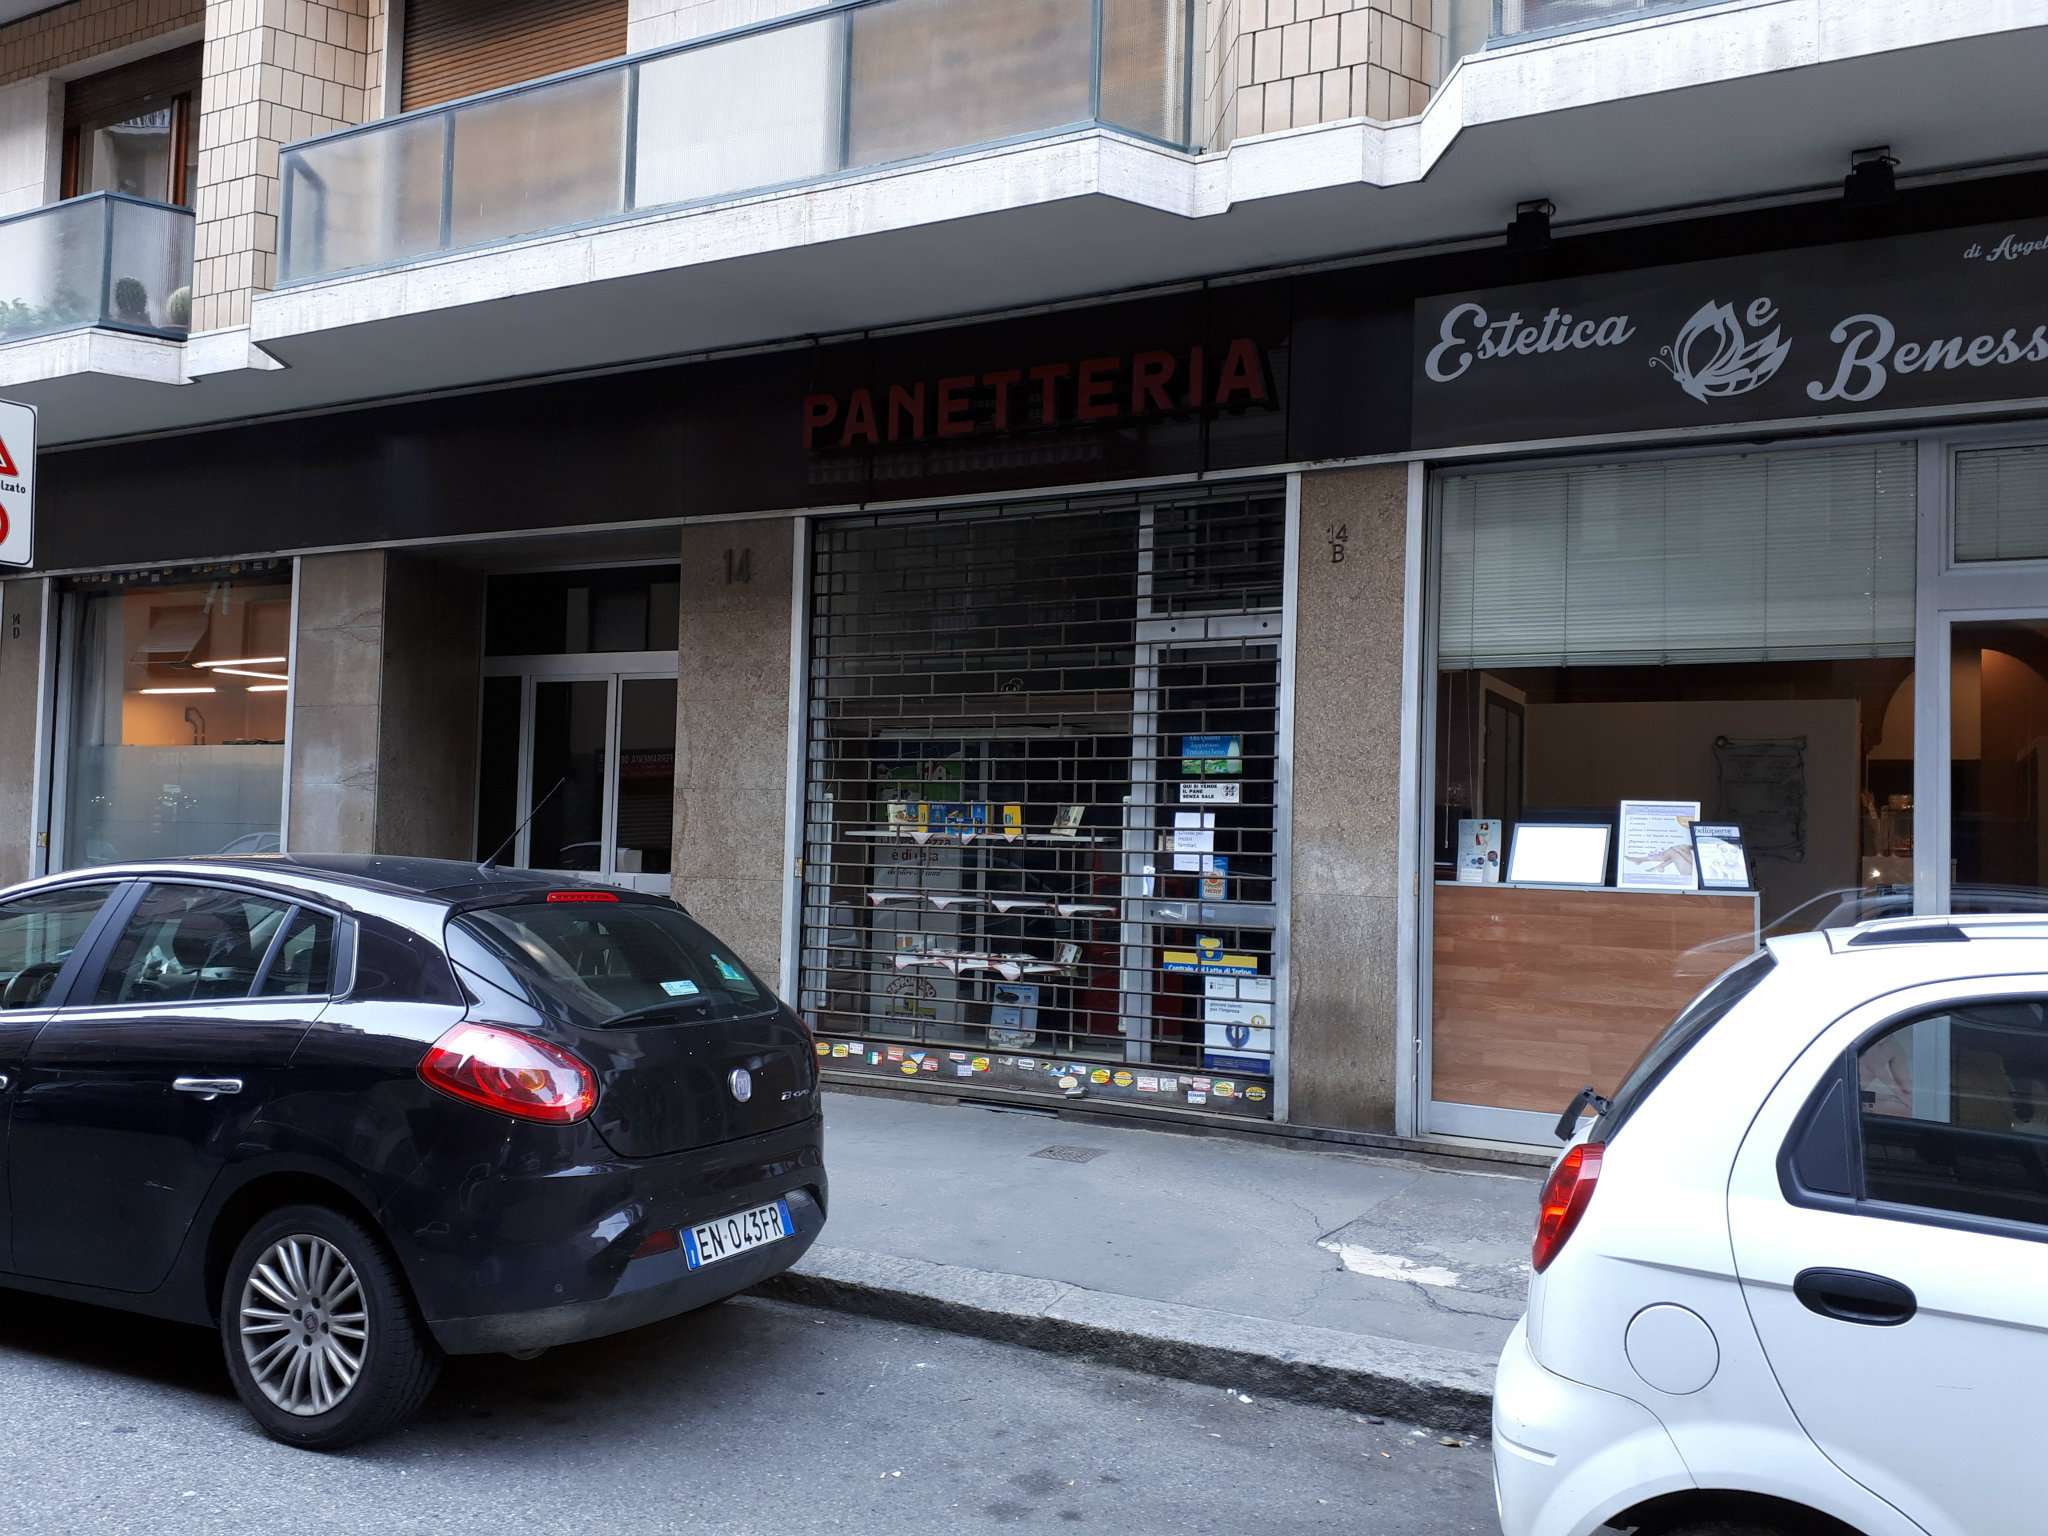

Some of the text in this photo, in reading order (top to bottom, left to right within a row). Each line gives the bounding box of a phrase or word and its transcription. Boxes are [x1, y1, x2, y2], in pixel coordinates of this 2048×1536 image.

[1962, 233, 2048, 262] di Angel
[1424, 303, 1638, 383] Estetica
[1746, 297, 1780, 329] e
[802, 338, 1268, 449] PANETTERIA
[1326, 523, 1348, 544] 14
[1331, 543, 1345, 564] B
[696, 1206, 782, 1261] EN 043FR
